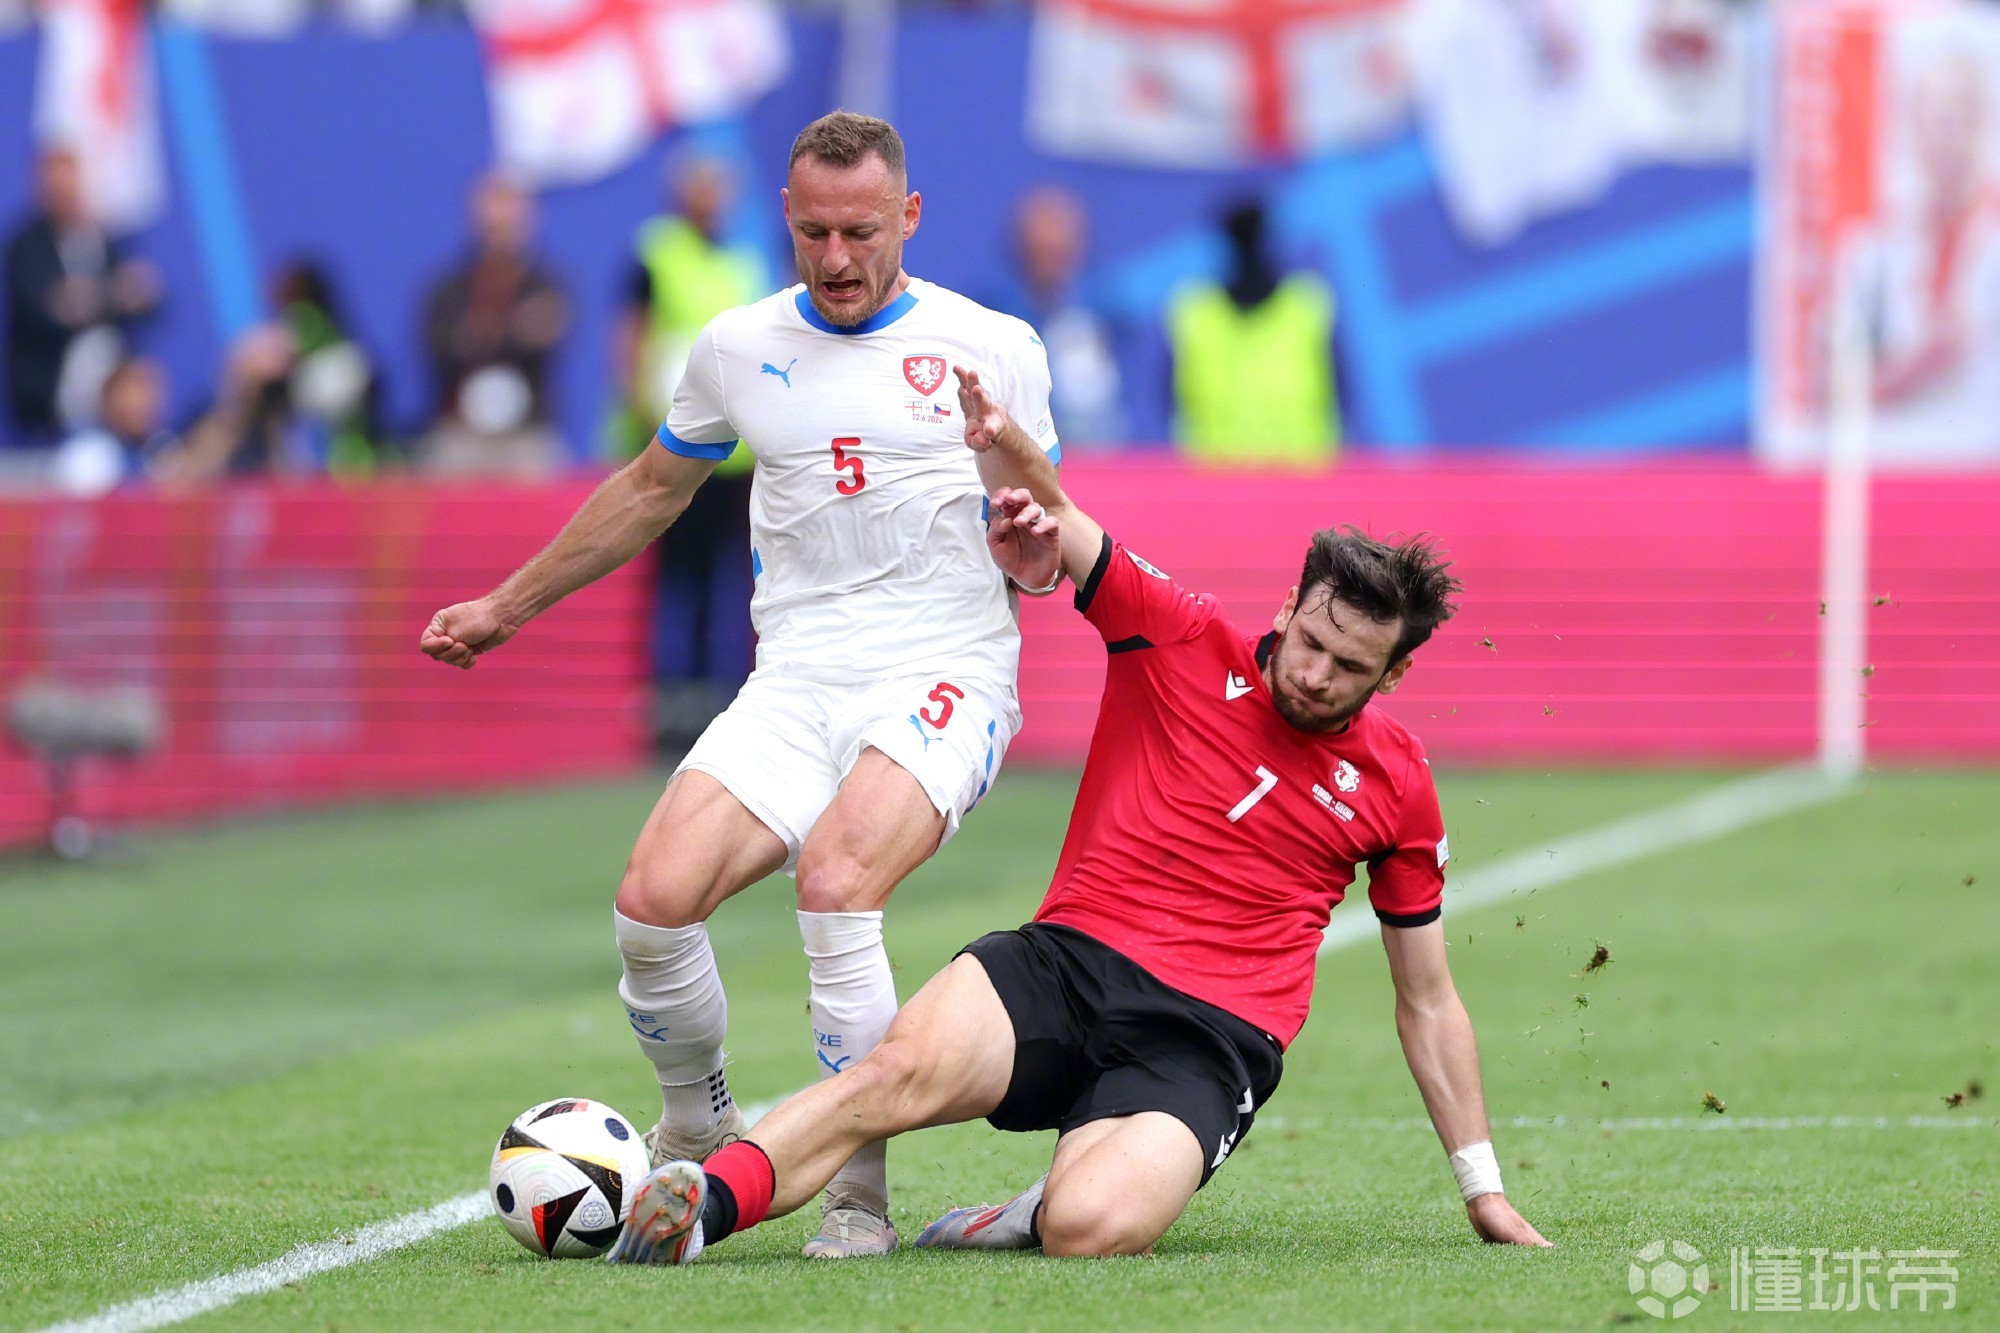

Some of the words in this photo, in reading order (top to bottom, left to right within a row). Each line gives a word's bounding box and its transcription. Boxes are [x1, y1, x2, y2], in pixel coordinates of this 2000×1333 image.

[912, 413, 943, 424] 22.6.2024
[831, 437, 866, 495] 5
[920, 682, 964, 729] 5
[1225, 765, 1279, 823] 7
